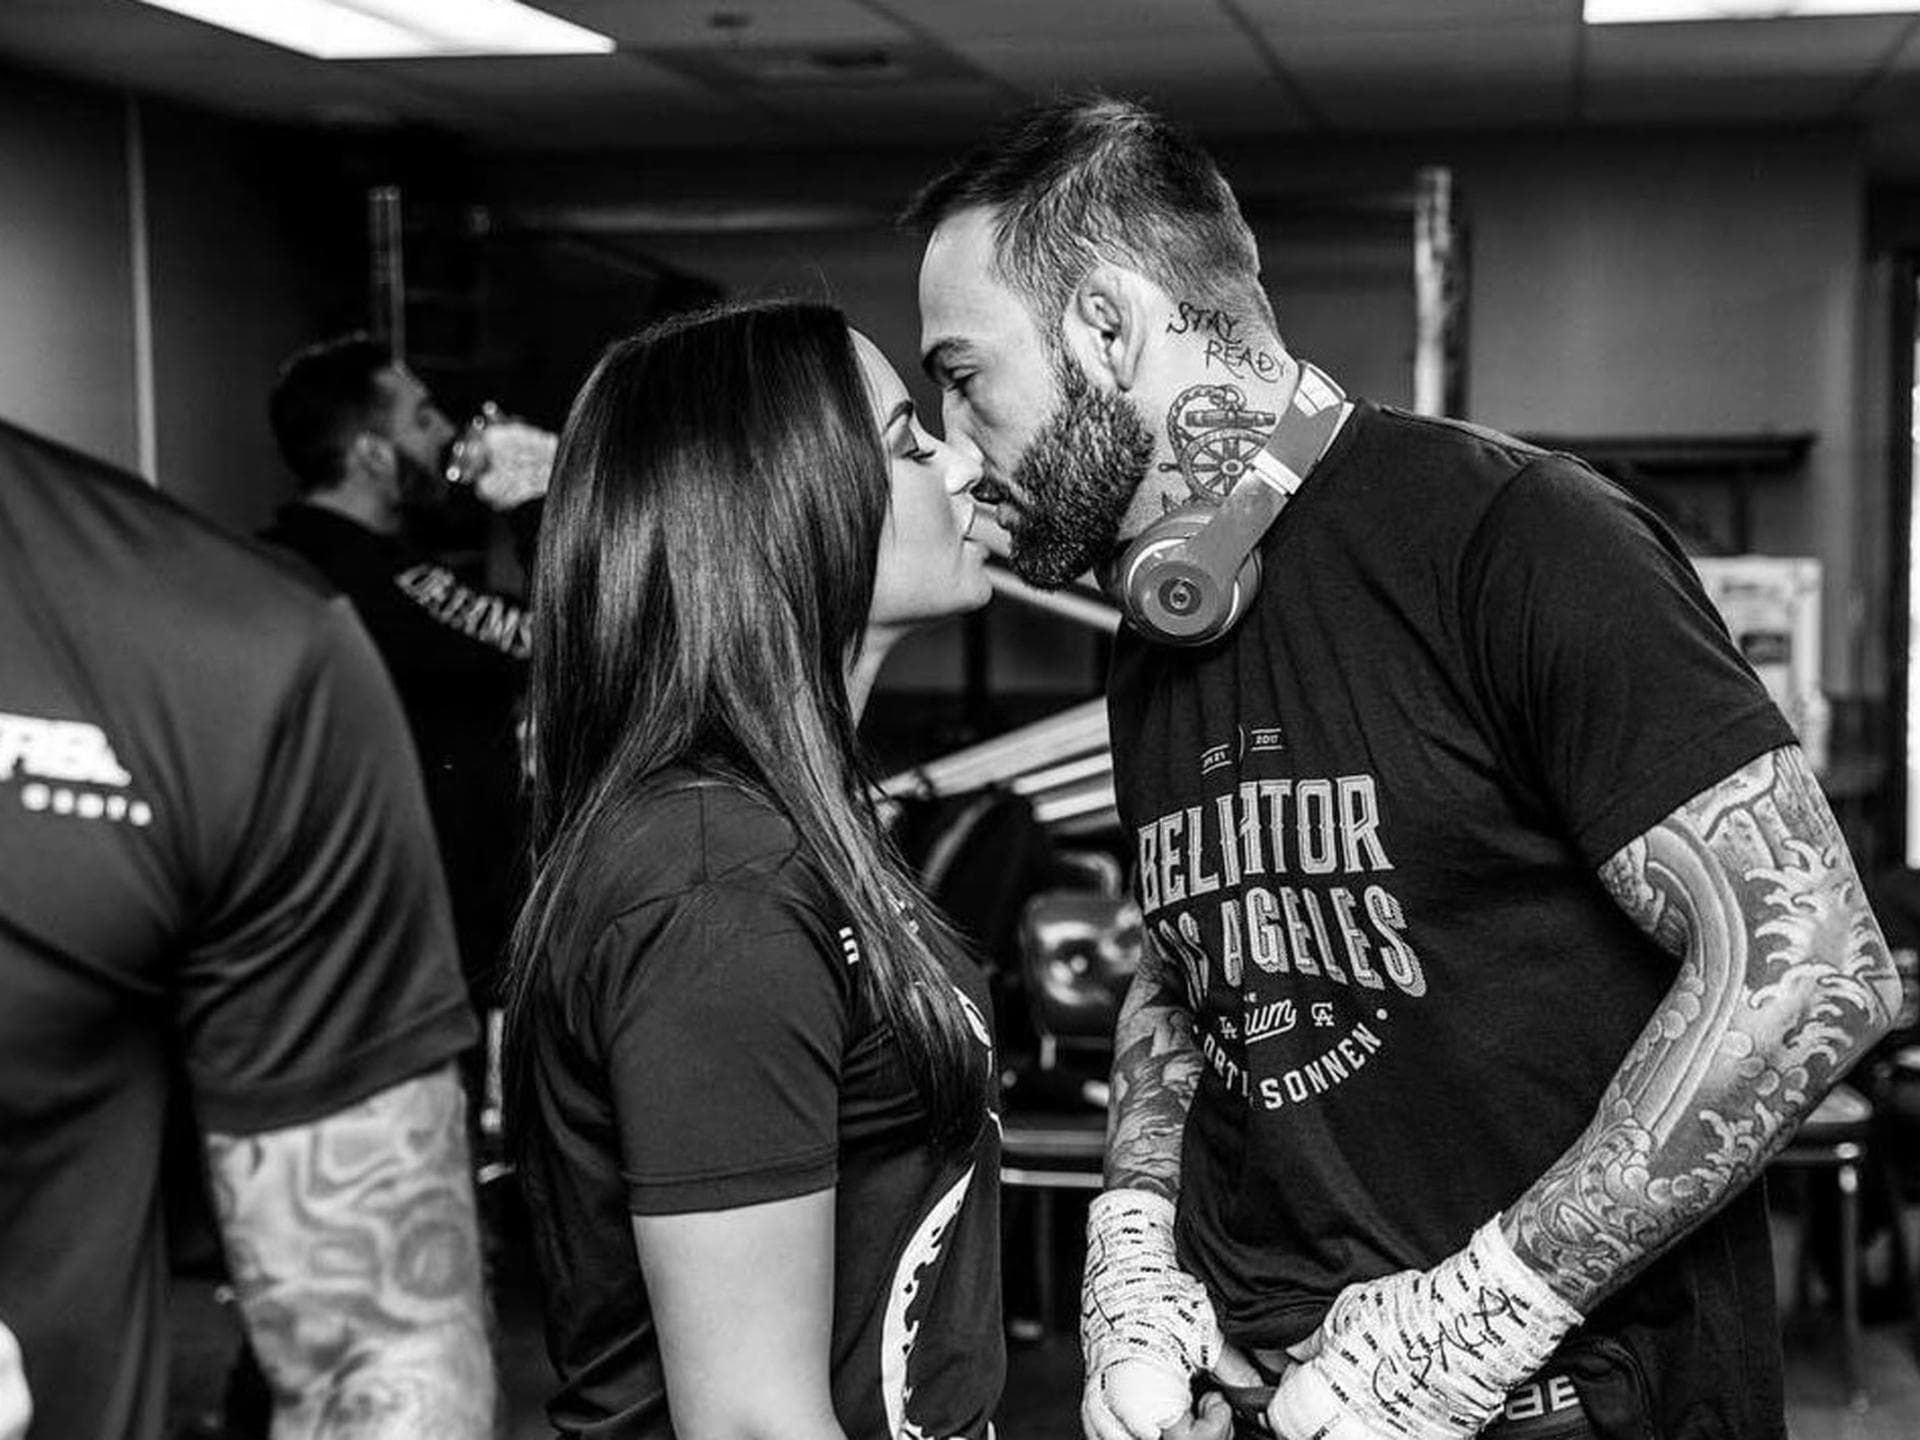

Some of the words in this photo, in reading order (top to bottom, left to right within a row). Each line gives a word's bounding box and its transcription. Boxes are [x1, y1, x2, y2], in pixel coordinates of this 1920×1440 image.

[1166, 301, 1242, 344] STAY
[1220, 884, 1427, 998] AGELES
[1204, 1033, 1249, 1098] ORTI
[1260, 1022, 1382, 1109] SONNEN
